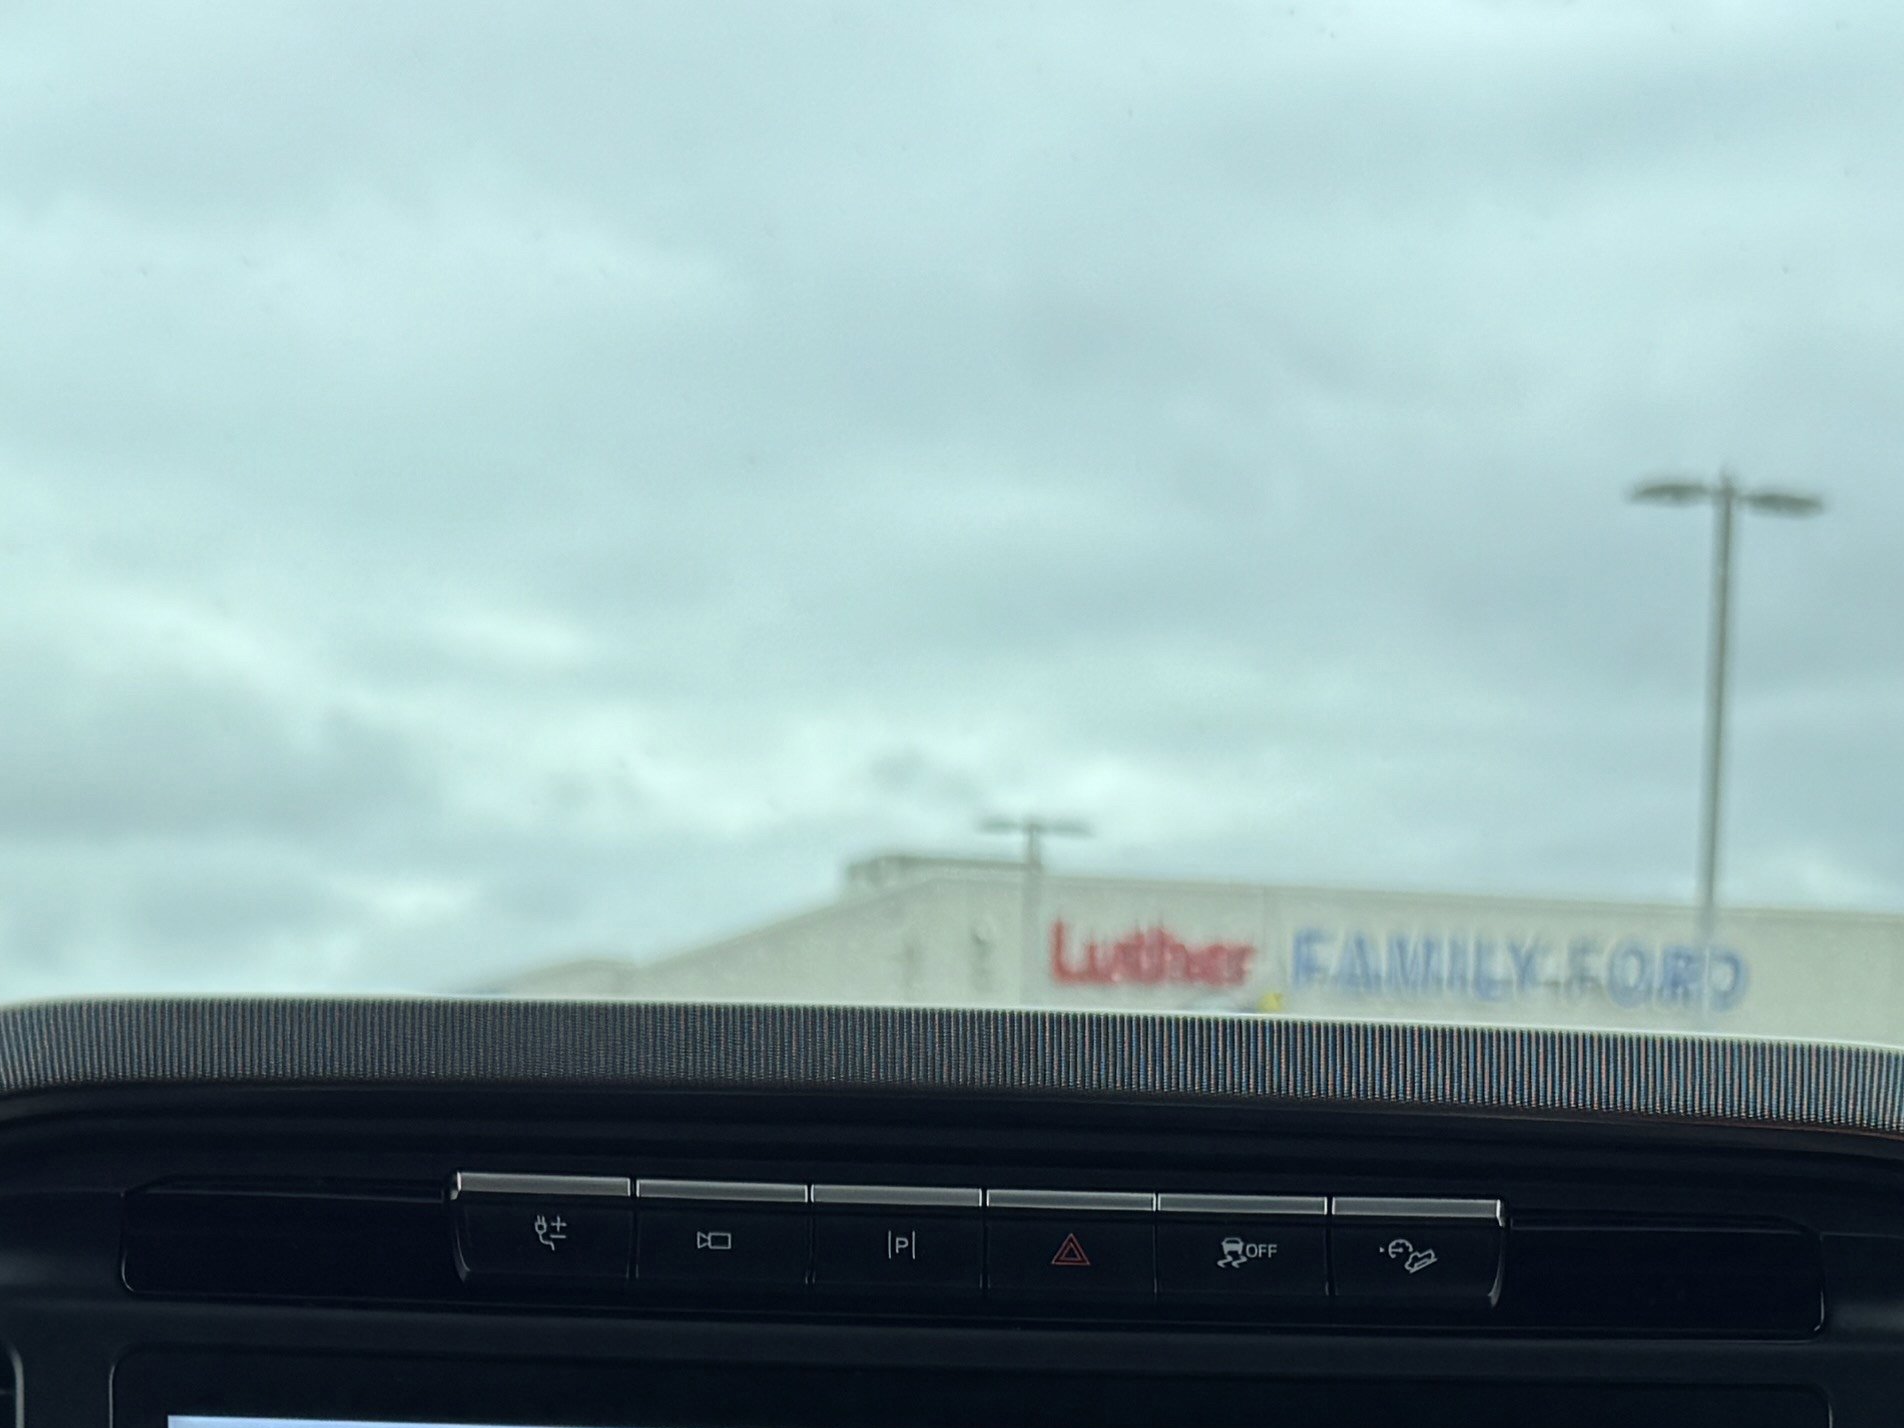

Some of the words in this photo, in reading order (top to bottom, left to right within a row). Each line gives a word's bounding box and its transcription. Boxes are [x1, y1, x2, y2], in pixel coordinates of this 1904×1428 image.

[1050, 921, 1255, 985] Luther
[1291, 926, 1537, 998] FAMILY
[1568, 938, 1750, 1009] FORD
[1245, 1243, 1278, 1258] OFF
